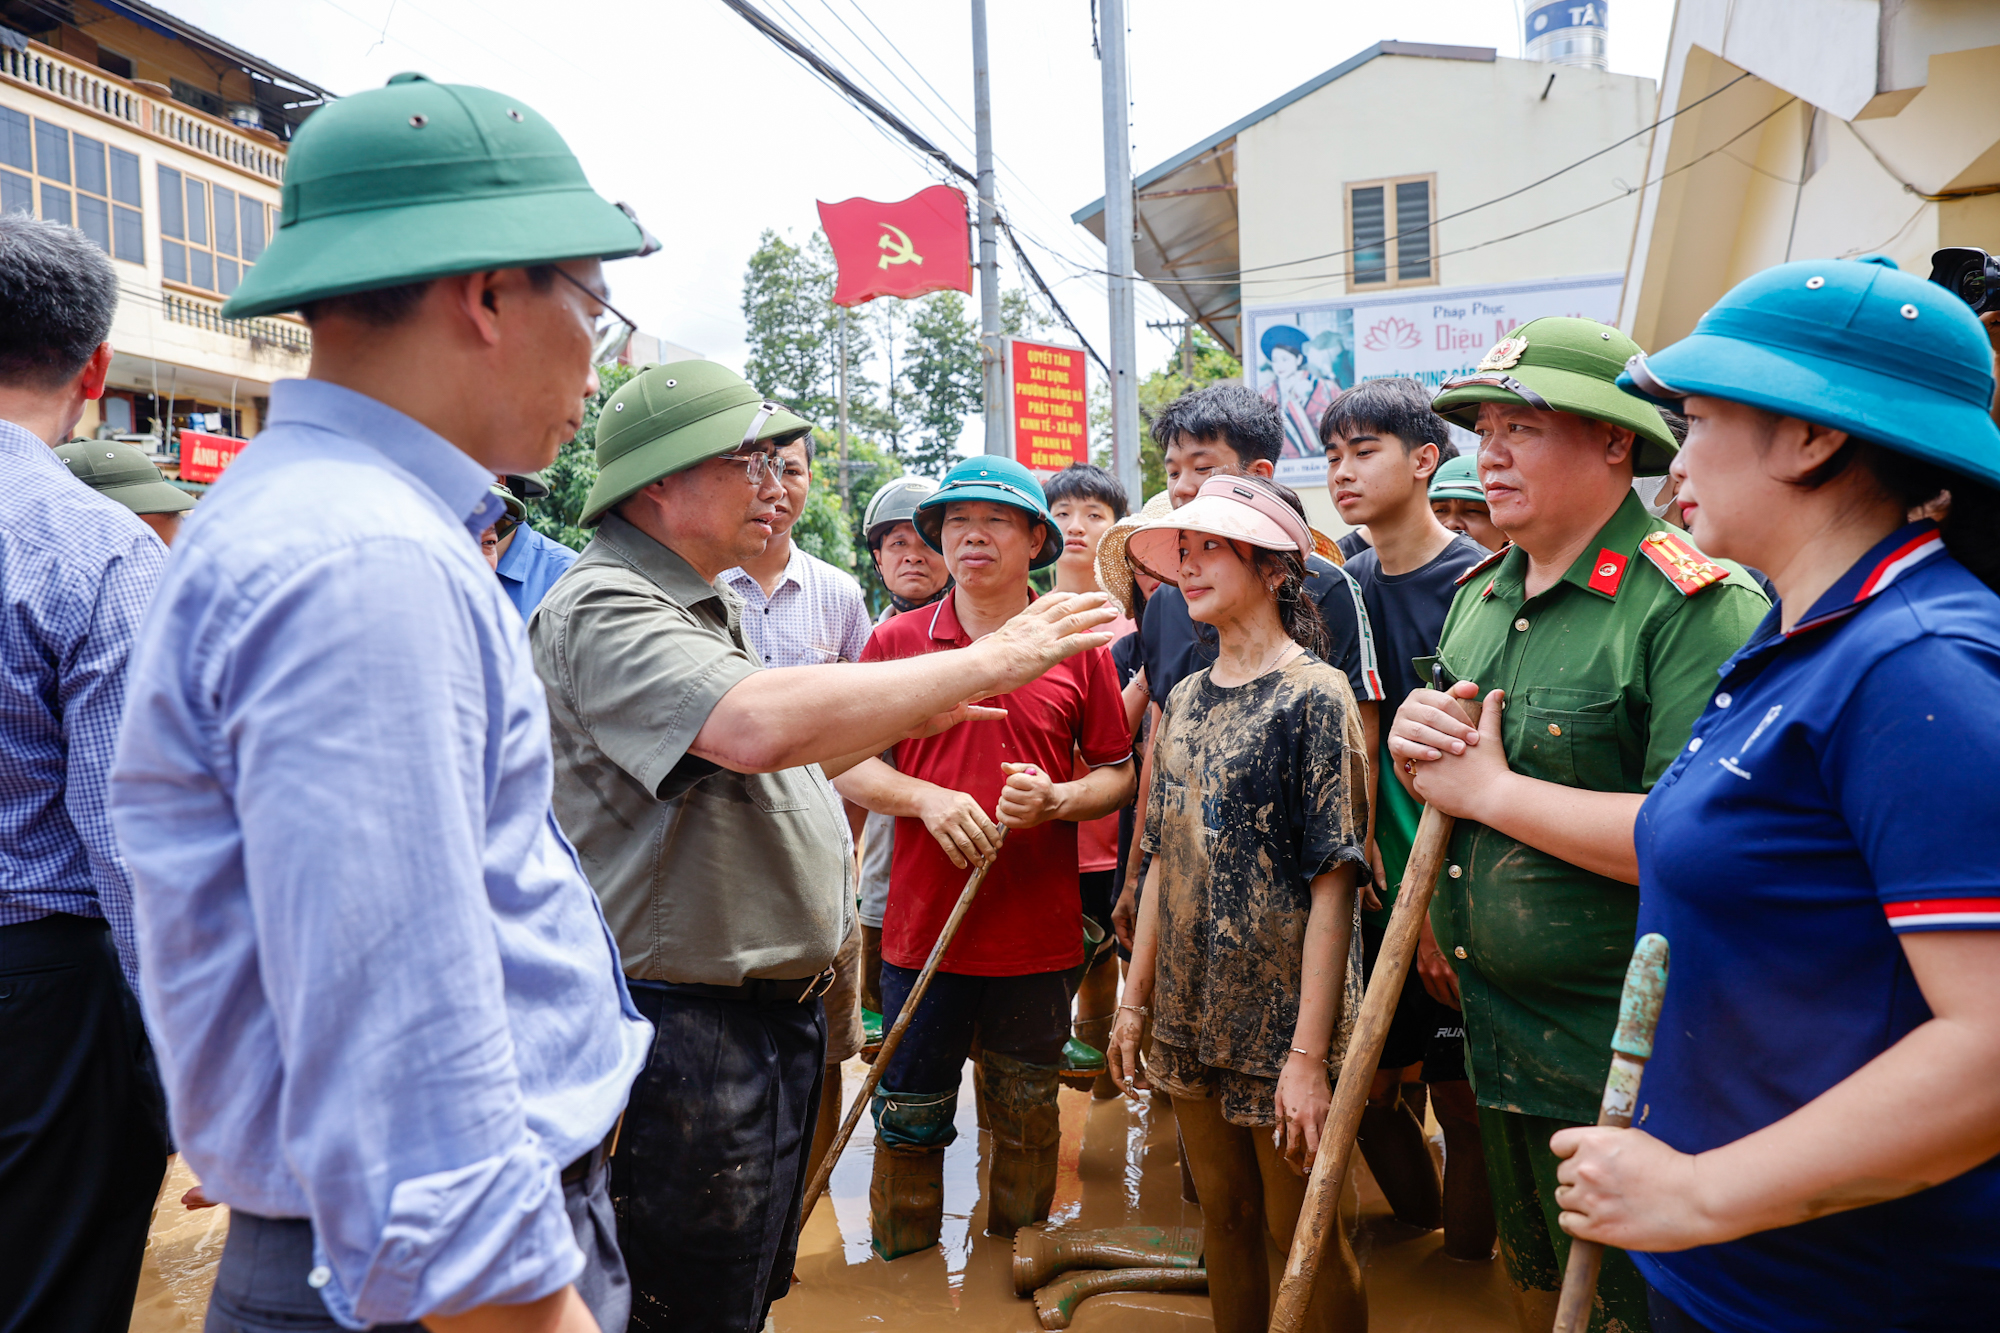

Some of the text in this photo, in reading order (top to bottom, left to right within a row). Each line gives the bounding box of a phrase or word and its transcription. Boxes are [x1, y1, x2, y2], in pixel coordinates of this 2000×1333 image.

[1433, 302, 1506, 320] Pháp Phục
[1436, 324, 1484, 354] Diệu
[1027, 349, 1071, 368] QUYẾT TÂM
[1030, 366, 1070, 385] XÂY DỰNG
[1016, 382, 1050, 399] PHƯỜNG
[1028, 401, 1074, 418] PHÁT TRIỂN
[1020, 417, 1041, 431] KINH
[1041, 417, 1052, 432] TẾ
[1056, 419, 1068, 434] XÃ
[1068, 421, 1083, 438] HỘI
[1032, 435, 1073, 451] NHANH VÀ
[191, 439, 219, 468] ẢNH
[1031, 449, 1049, 466] BỀN
